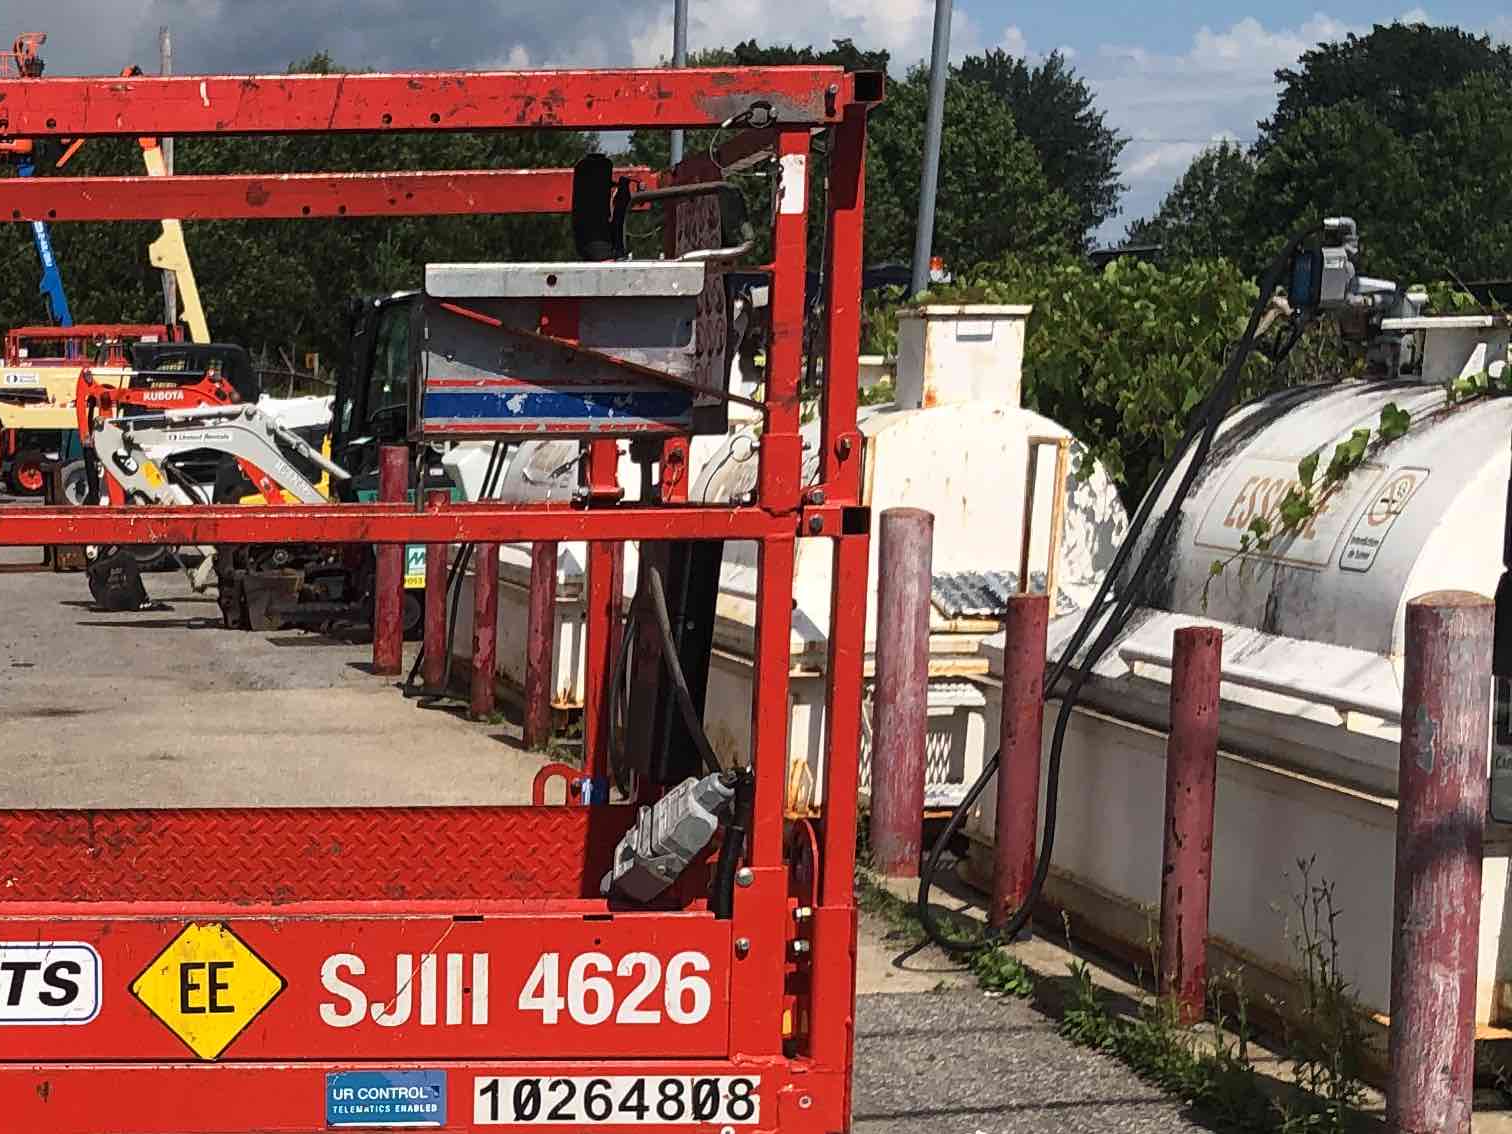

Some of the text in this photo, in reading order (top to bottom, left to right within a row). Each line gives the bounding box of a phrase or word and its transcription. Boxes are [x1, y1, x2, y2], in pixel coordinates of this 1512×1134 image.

[143, 390, 185, 401] KUBOTA
[180, 961, 235, 1014] EE
[518, 951, 711, 1025] 4626
[333, 1086, 428, 1100] UR CONTROL
[479, 1078, 755, 1121] 10264808
[333, 1104, 438, 1114] TELEMATICS ENABLED
